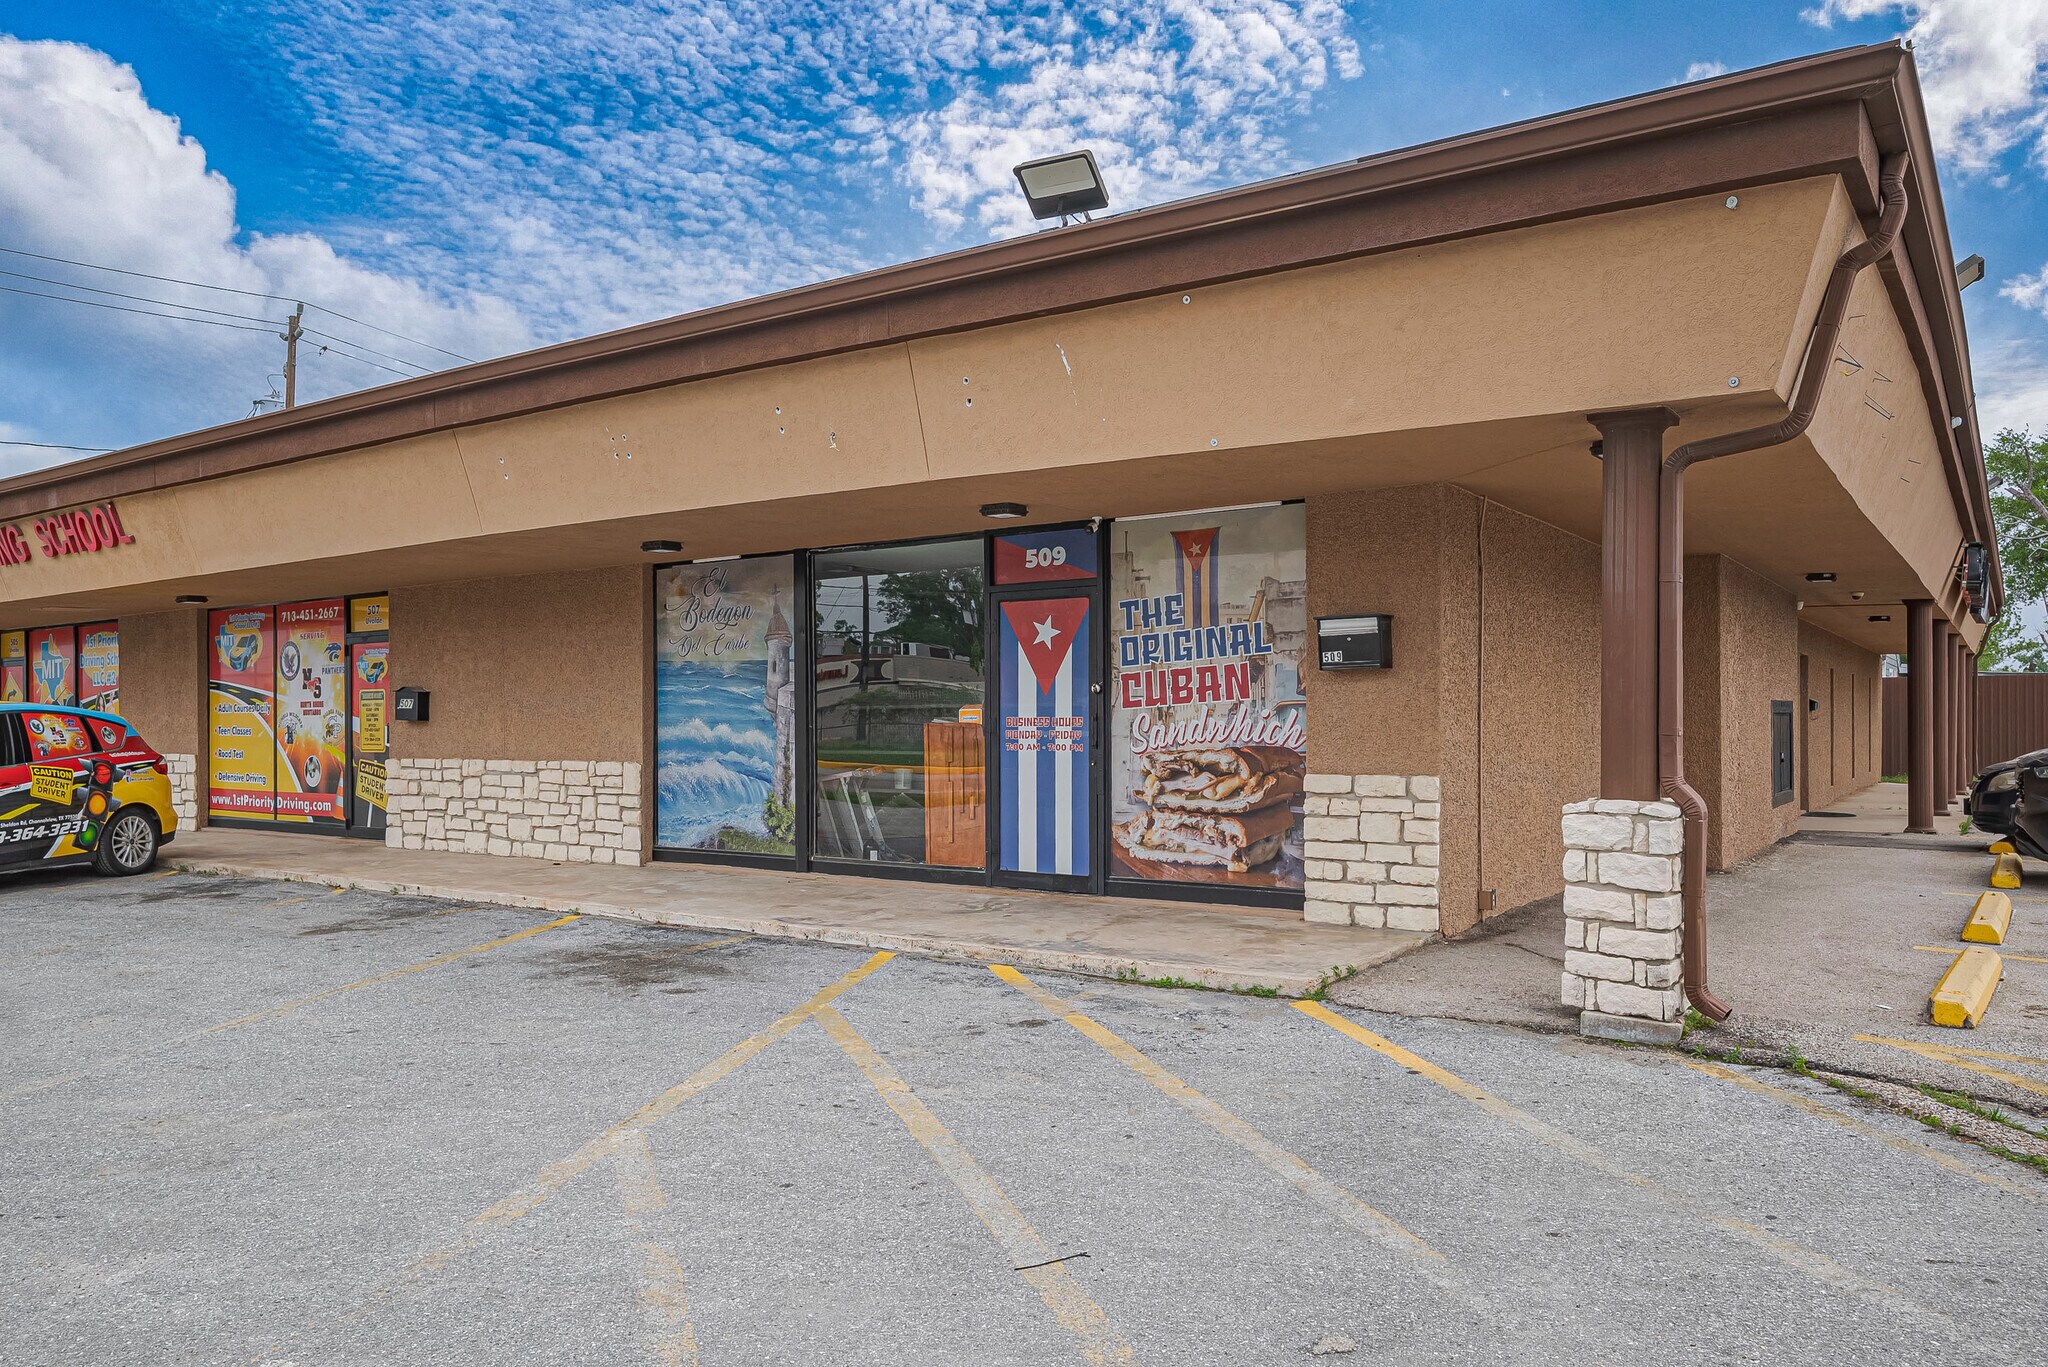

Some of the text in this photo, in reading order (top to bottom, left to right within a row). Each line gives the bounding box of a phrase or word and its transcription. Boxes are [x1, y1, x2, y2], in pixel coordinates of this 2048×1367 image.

[34, 501, 136, 558] SCHOOL
[1025, 546, 1066, 568] 509
[691, 567, 728, 597] El
[281, 606, 339, 623] 713-451-2667
[367, 605, 380, 615] 507
[664, 596, 755, 632] Bodegon
[1119, 592, 1184, 632] THE
[300, 631, 324, 640] SERVING
[669, 633, 750, 657] Del Caribe
[1119, 620, 1273, 667] ORIGINAL
[80, 653, 105, 669] Driving
[1323, 651, 1342, 662] 509
[42, 659, 62, 679] MIT
[92, 670, 117, 687] LLC #2
[1120, 661, 1251, 710] CUBAN
[218, 702, 271, 715] Adult Courses Daily
[399, 699, 414, 709] 507
[1006, 717, 1084, 727] BUSINESS HOURS
[1130, 703, 1307, 755] Sandwhich
[218, 725, 252, 736] Teen Classes
[1005, 730, 1042, 740] MONDAY
[1049, 730, 1082, 740] FRIDAY
[218, 749, 244, 759] Road Test
[1005, 743, 1024, 752] 7:00
[1026, 743, 1041, 751] AM
[1047, 743, 1067, 752] 7:00
[1069, 743, 1084, 752] PM
[33, 768, 72, 780] CAUTION
[218, 772, 266, 786] Defensive Driving
[35, 778, 70, 790] STUDENT
[360, 776, 386, 791] STUDEN
[37, 786, 66, 798] DRIVER
[361, 785, 384, 802] DRIVER
